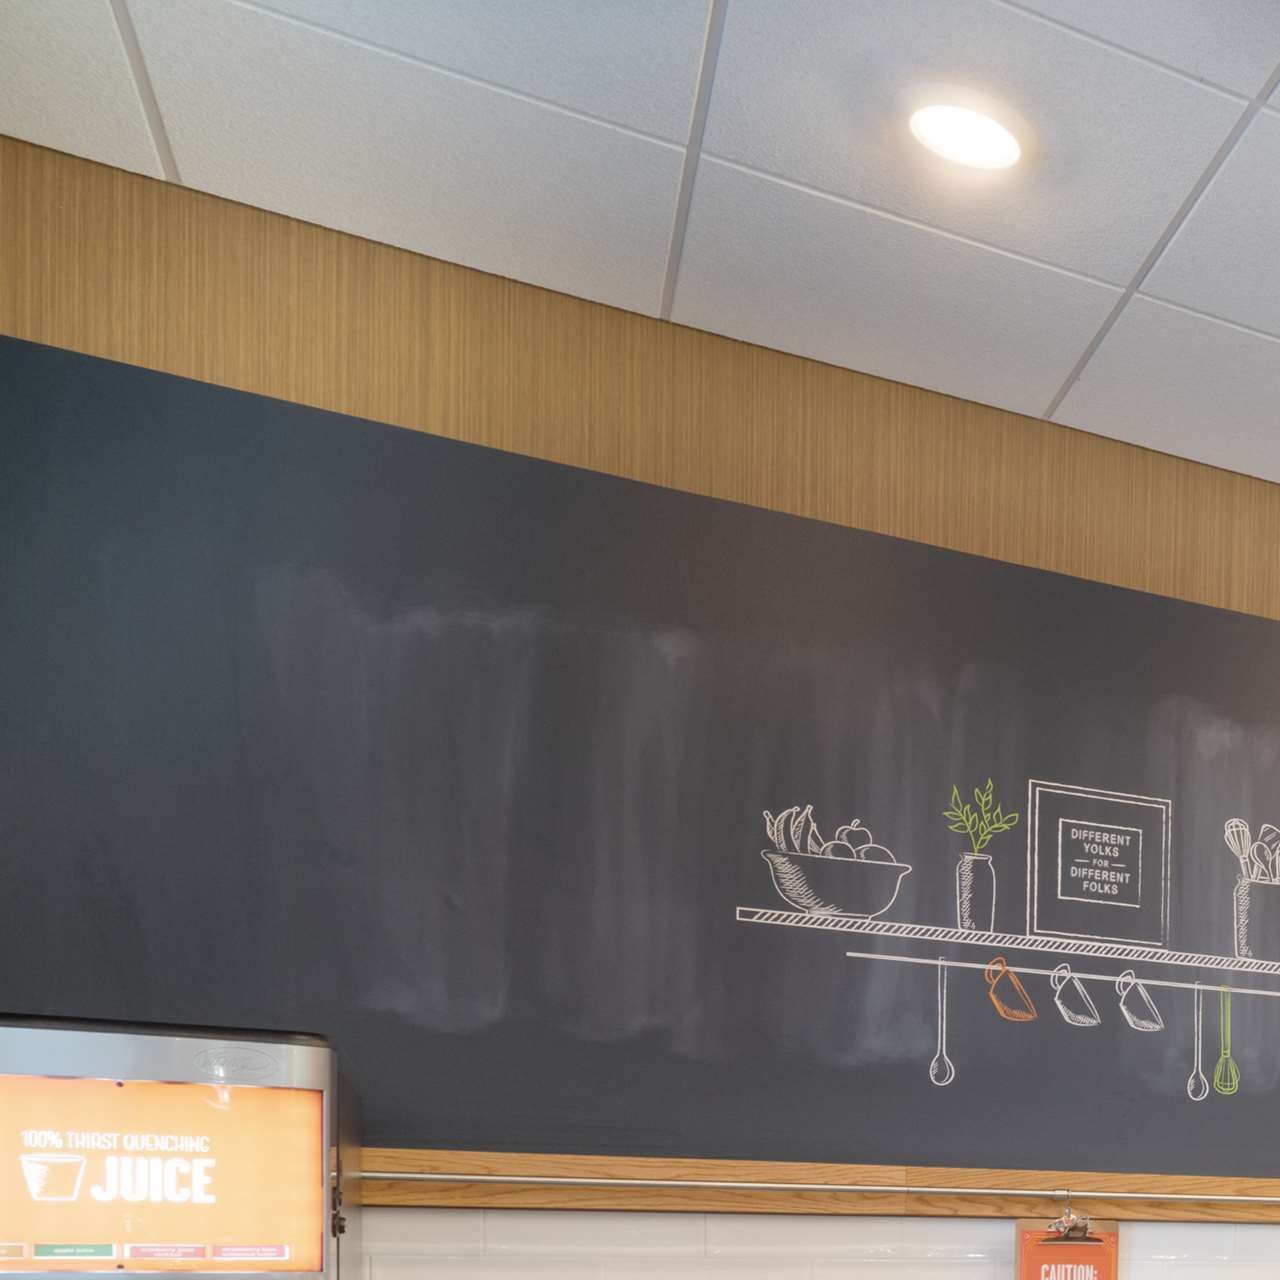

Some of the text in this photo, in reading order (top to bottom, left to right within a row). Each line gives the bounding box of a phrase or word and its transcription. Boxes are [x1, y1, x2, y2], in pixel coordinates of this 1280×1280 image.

[1071, 828, 1132, 846] DIFFERENT
[1084, 843, 1119, 857] YOLKS
[1092, 859, 1110, 868] FOR
[1070, 866, 1131, 884] DIFFERENT
[1082, 881, 1119, 895] FOLKS
[21, 1130, 210, 1153] 100% THIRST QUENCHING
[90, 1156, 216, 1204] JUICE
